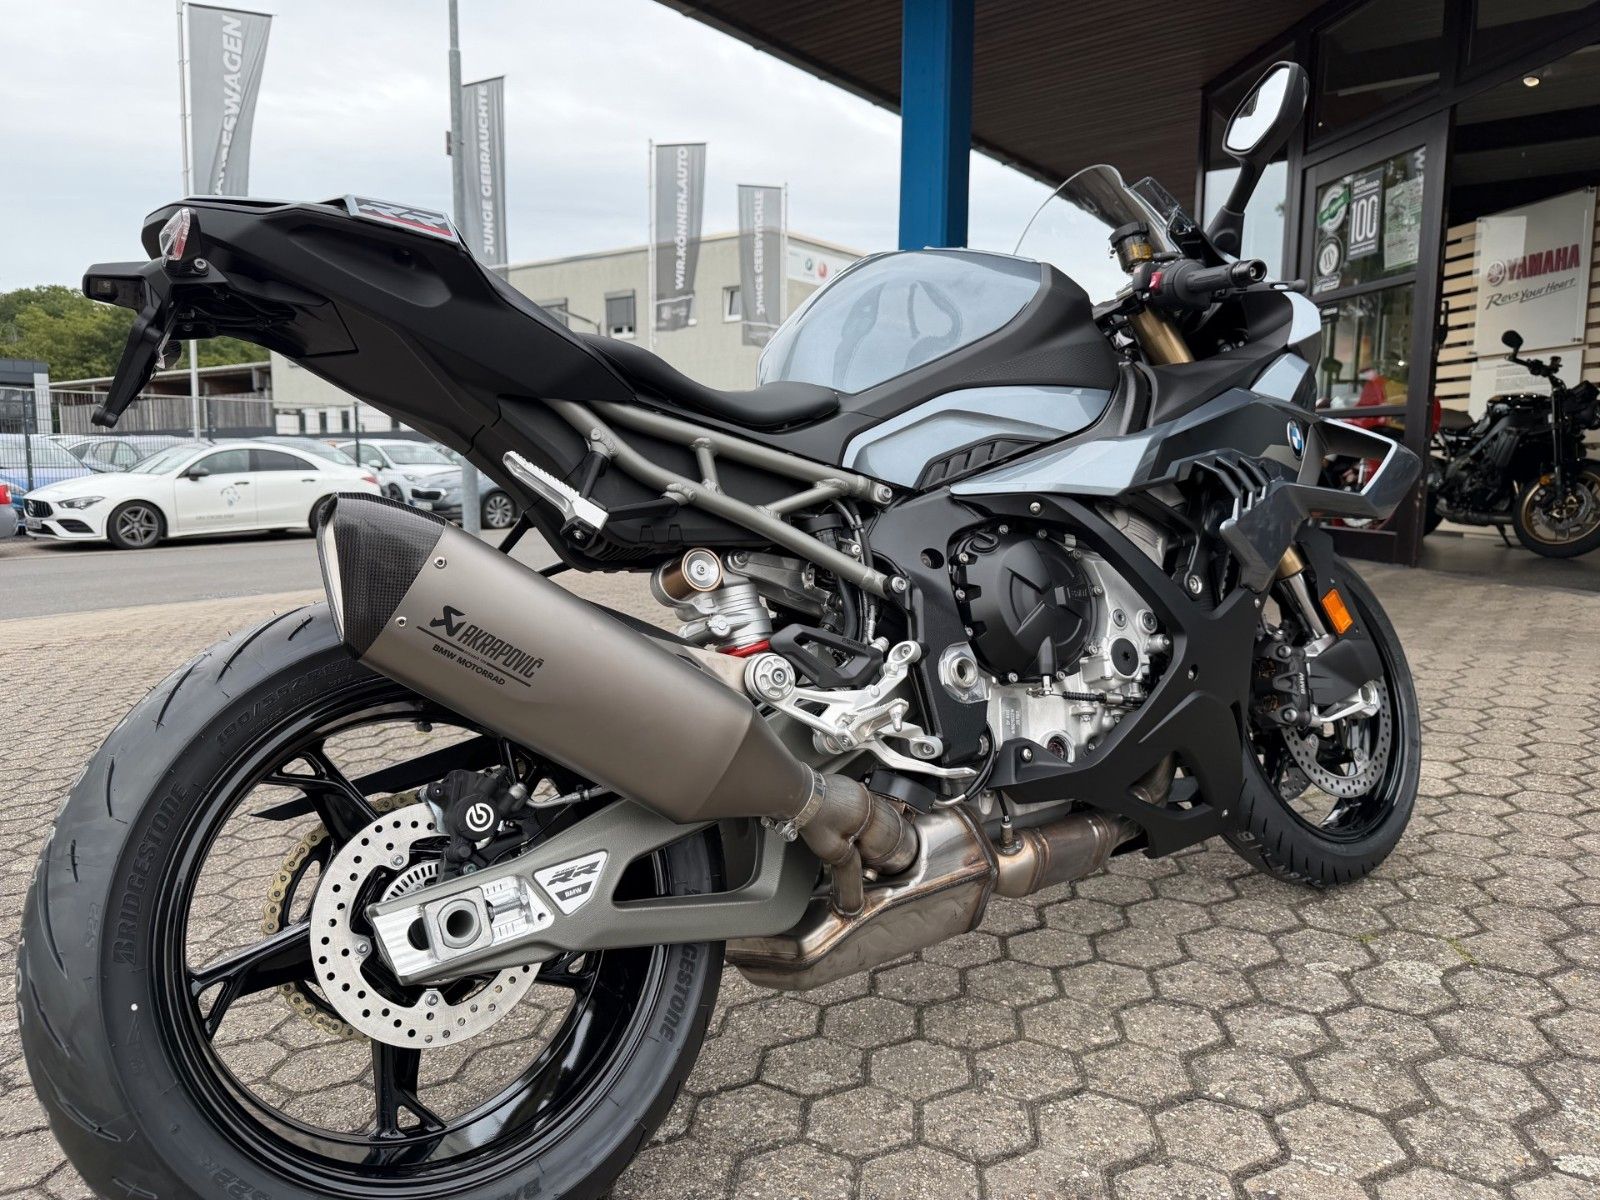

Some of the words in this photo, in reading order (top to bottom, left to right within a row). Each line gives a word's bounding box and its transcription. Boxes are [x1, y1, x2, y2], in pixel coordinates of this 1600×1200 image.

[478, 85, 492, 198] GEBRAUCHTE
[482, 200, 494, 255] JUNGE
[1350, 195, 1378, 243] 100
[1507, 244, 1580, 280] YAMAHA
[1485, 292, 1519, 310] Revs
[1519, 286, 1546, 303] Your
[1546, 278, 1575, 293] Heart
[432, 644, 457, 660] BMW
[457, 656, 506, 685] MOTORRAD
[112, 781, 188, 967] BRIDGESTONE
[565, 886, 582, 898] BMW
